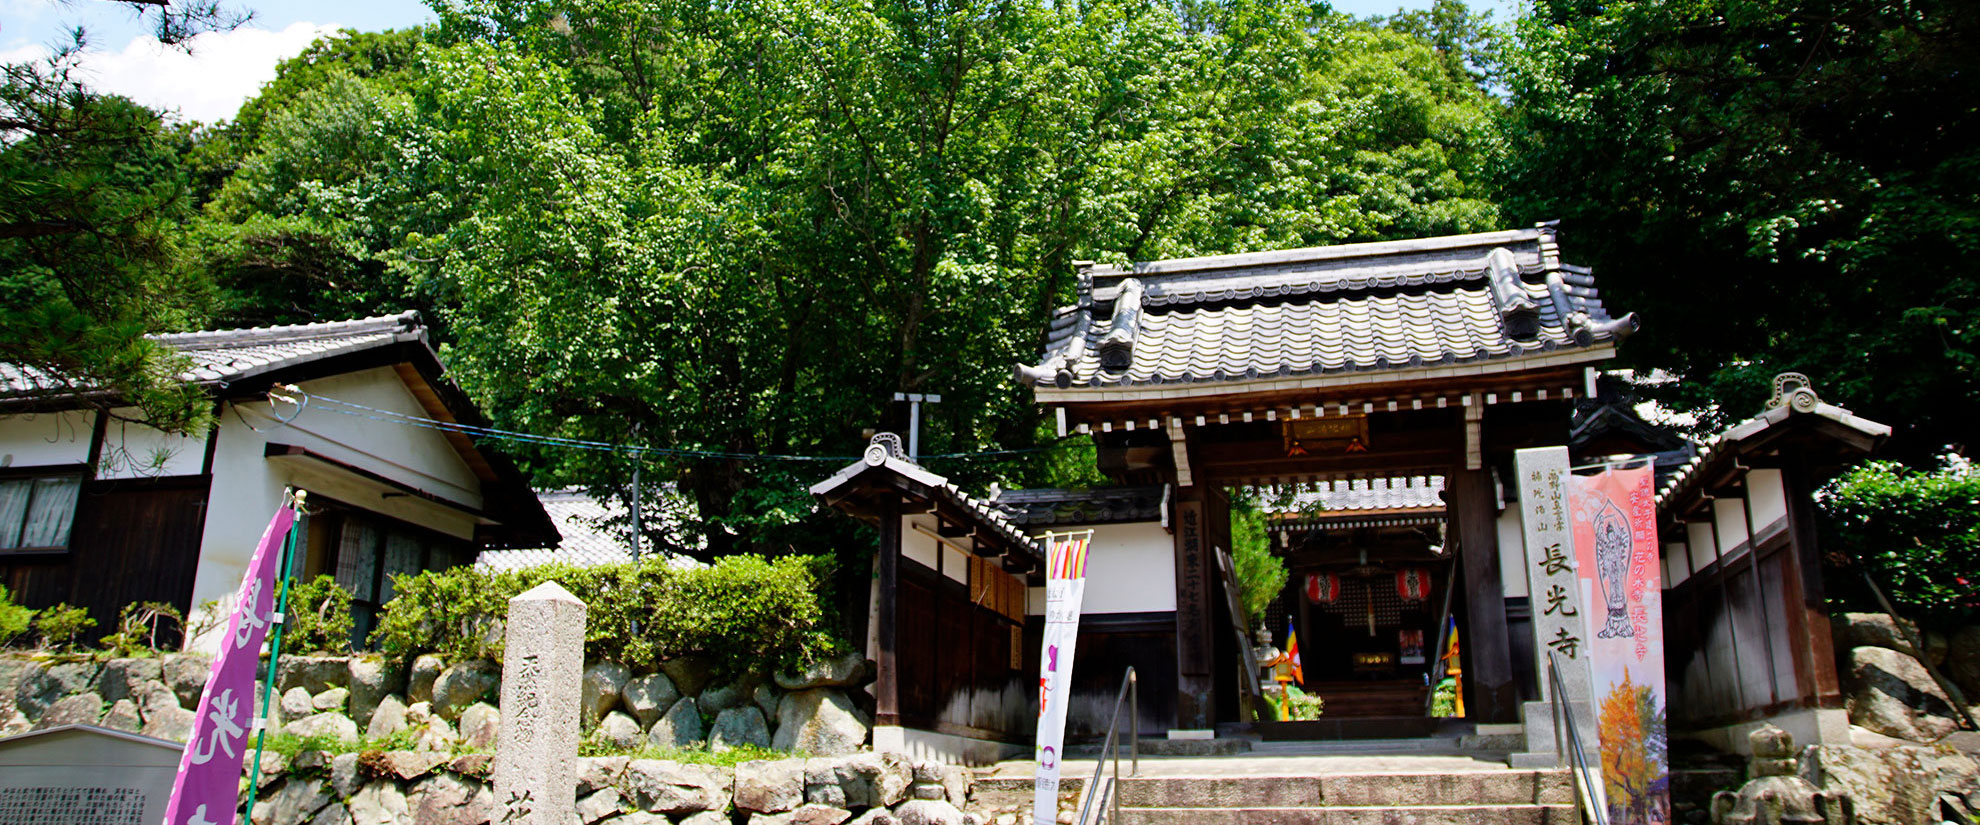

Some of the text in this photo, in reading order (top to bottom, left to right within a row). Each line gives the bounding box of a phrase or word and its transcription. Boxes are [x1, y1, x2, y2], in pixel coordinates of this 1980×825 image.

[1538, 543, 1581, 660] 長光寺
[1632, 551, 1645, 602] 花の木寺
[1632, 606, 1649, 664] 長光寺
